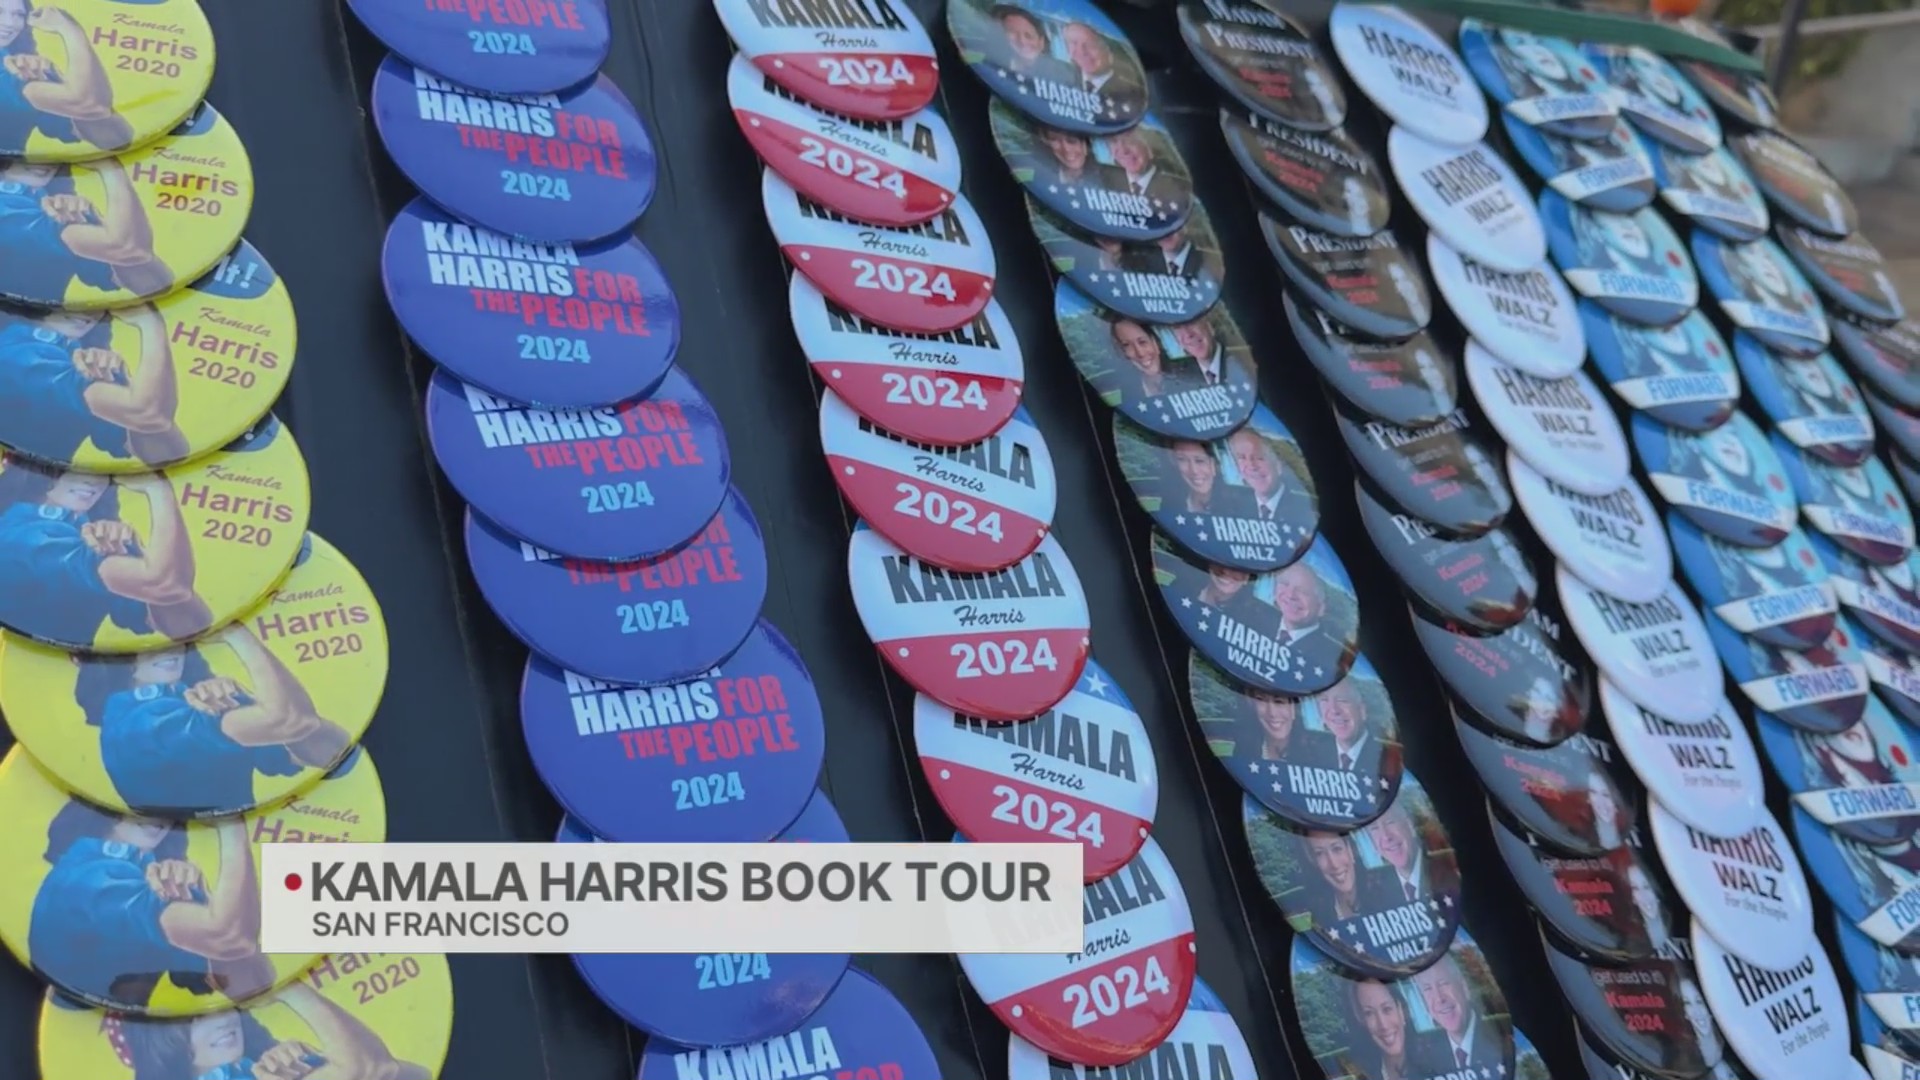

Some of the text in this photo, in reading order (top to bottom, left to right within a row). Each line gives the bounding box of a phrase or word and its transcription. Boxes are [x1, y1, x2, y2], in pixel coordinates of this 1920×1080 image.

[112, 12, 185, 35] Kamala
[466, 0, 584, 31] PEOPLE
[750, 0, 909, 31] KAMALA
[93, 27, 198, 61] Harris
[468, 31, 536, 56] 2024
[815, 32, 879, 48] Harris
[1359, 24, 1460, 86] HARRIS
[116, 55, 181, 78] 2020
[818, 58, 915, 86] 2024
[1034, 77, 1103, 114] HARRIS
[1049, 102, 1096, 124] WALZ
[417, 88, 555, 137] HARRIS
[555, 111, 621, 149] FOR
[457, 125, 628, 180] THE PEOPLE
[816, 118, 889, 157] Harris
[153, 147, 226, 169] Kamala
[798, 137, 907, 199] 2024
[132, 162, 239, 197] Harris
[501, 170, 572, 201] 2024
[1421, 149, 1502, 207] HARRIS
[156, 193, 222, 217] 2020
[1084, 188, 1152, 218] HARRIS
[1464, 190, 1514, 225] WALZ
[1102, 212, 1149, 230] WALZ
[422, 221, 580, 266] KAMALA
[858, 231, 930, 257] Harris
[428, 252, 644, 304] HARRIS FOR
[850, 258, 957, 301] 2024
[1123, 272, 1190, 299] HARRIS
[1599, 271, 1683, 297] FORWARD
[200, 307, 272, 337] Kamala
[470, 289, 651, 337] THE PEOPLE
[1142, 298, 1186, 314] WALZ
[1487, 292, 1556, 329] WALZ
[171, 321, 279, 370] Harris
[517, 334, 591, 364] 2024
[888, 342, 960, 365] Harris
[189, 357, 256, 389] 2020
[1493, 367, 1592, 411] HARRIS
[1647, 375, 1729, 399] FORWARD
[882, 372, 988, 411] 2024
[1168, 385, 1233, 419] HARRIS
[475, 399, 690, 448] HARRIS FOR
[1192, 413, 1233, 432] WALZ
[1532, 411, 1596, 436] WALZ
[525, 432, 703, 476] THE PEOPLE
[206, 464, 282, 490] Kamala
[913, 455, 987, 493] Harris
[181, 483, 293, 523] Harris
[581, 481, 655, 513] 2024
[893, 482, 1004, 544] 2024
[1688, 481, 1776, 524] FORWARD
[203, 519, 272, 547] 2020
[1211, 516, 1282, 546] HARRIS
[1569, 505, 1641, 549] WALZ
[613, 547, 742, 593] PEOPLE
[1230, 544, 1276, 561] WALZ
[268, 583, 345, 605] Kamala
[881, 551, 1066, 604] KAMALA
[257, 603, 370, 640] Harris
[616, 599, 690, 634] 2024
[953, 604, 1026, 627] Harris
[1750, 586, 1829, 623] FORWARD
[295, 634, 363, 663] 2020
[950, 637, 1059, 679] 2024
[1217, 615, 1291, 672] HARRIS
[1631, 628, 1692, 661] WALZ
[1227, 646, 1276, 682] WALZ
[1774, 666, 1859, 702] FORWARD
[570, 681, 719, 736] HARRIS
[716, 674, 788, 717] FOR
[618, 713, 800, 766] THE PEOPLE
[1668, 741, 1736, 770] WALZ
[1010, 752, 1086, 792] Harris
[1287, 765, 1361, 800] HARRIS
[671, 771, 746, 811] 2024
[1305, 797, 1355, 818] WALZ
[1827, 785, 1917, 817] FORWARD
[282, 795, 361, 824] Kamala
[991, 785, 1105, 848] 2024
[1713, 860, 1783, 902] WALZ
[1362, 902, 1433, 946] HARRIS
[1573, 899, 1613, 916] 2024
[1386, 935, 1432, 963] WALZ
[353, 957, 421, 1004] 2020
[695, 953, 771, 990] 2024
[1062, 956, 1170, 1029] 2024
[1604, 991, 1665, 1009] Kamala
[1764, 985, 1823, 1034] WALZ
[1625, 1014, 1664, 1031] 2024
[673, 1026, 841, 1080] KAMALA
[1780, 1038, 1795, 1056] For
[1794, 1032, 1810, 1049] the
